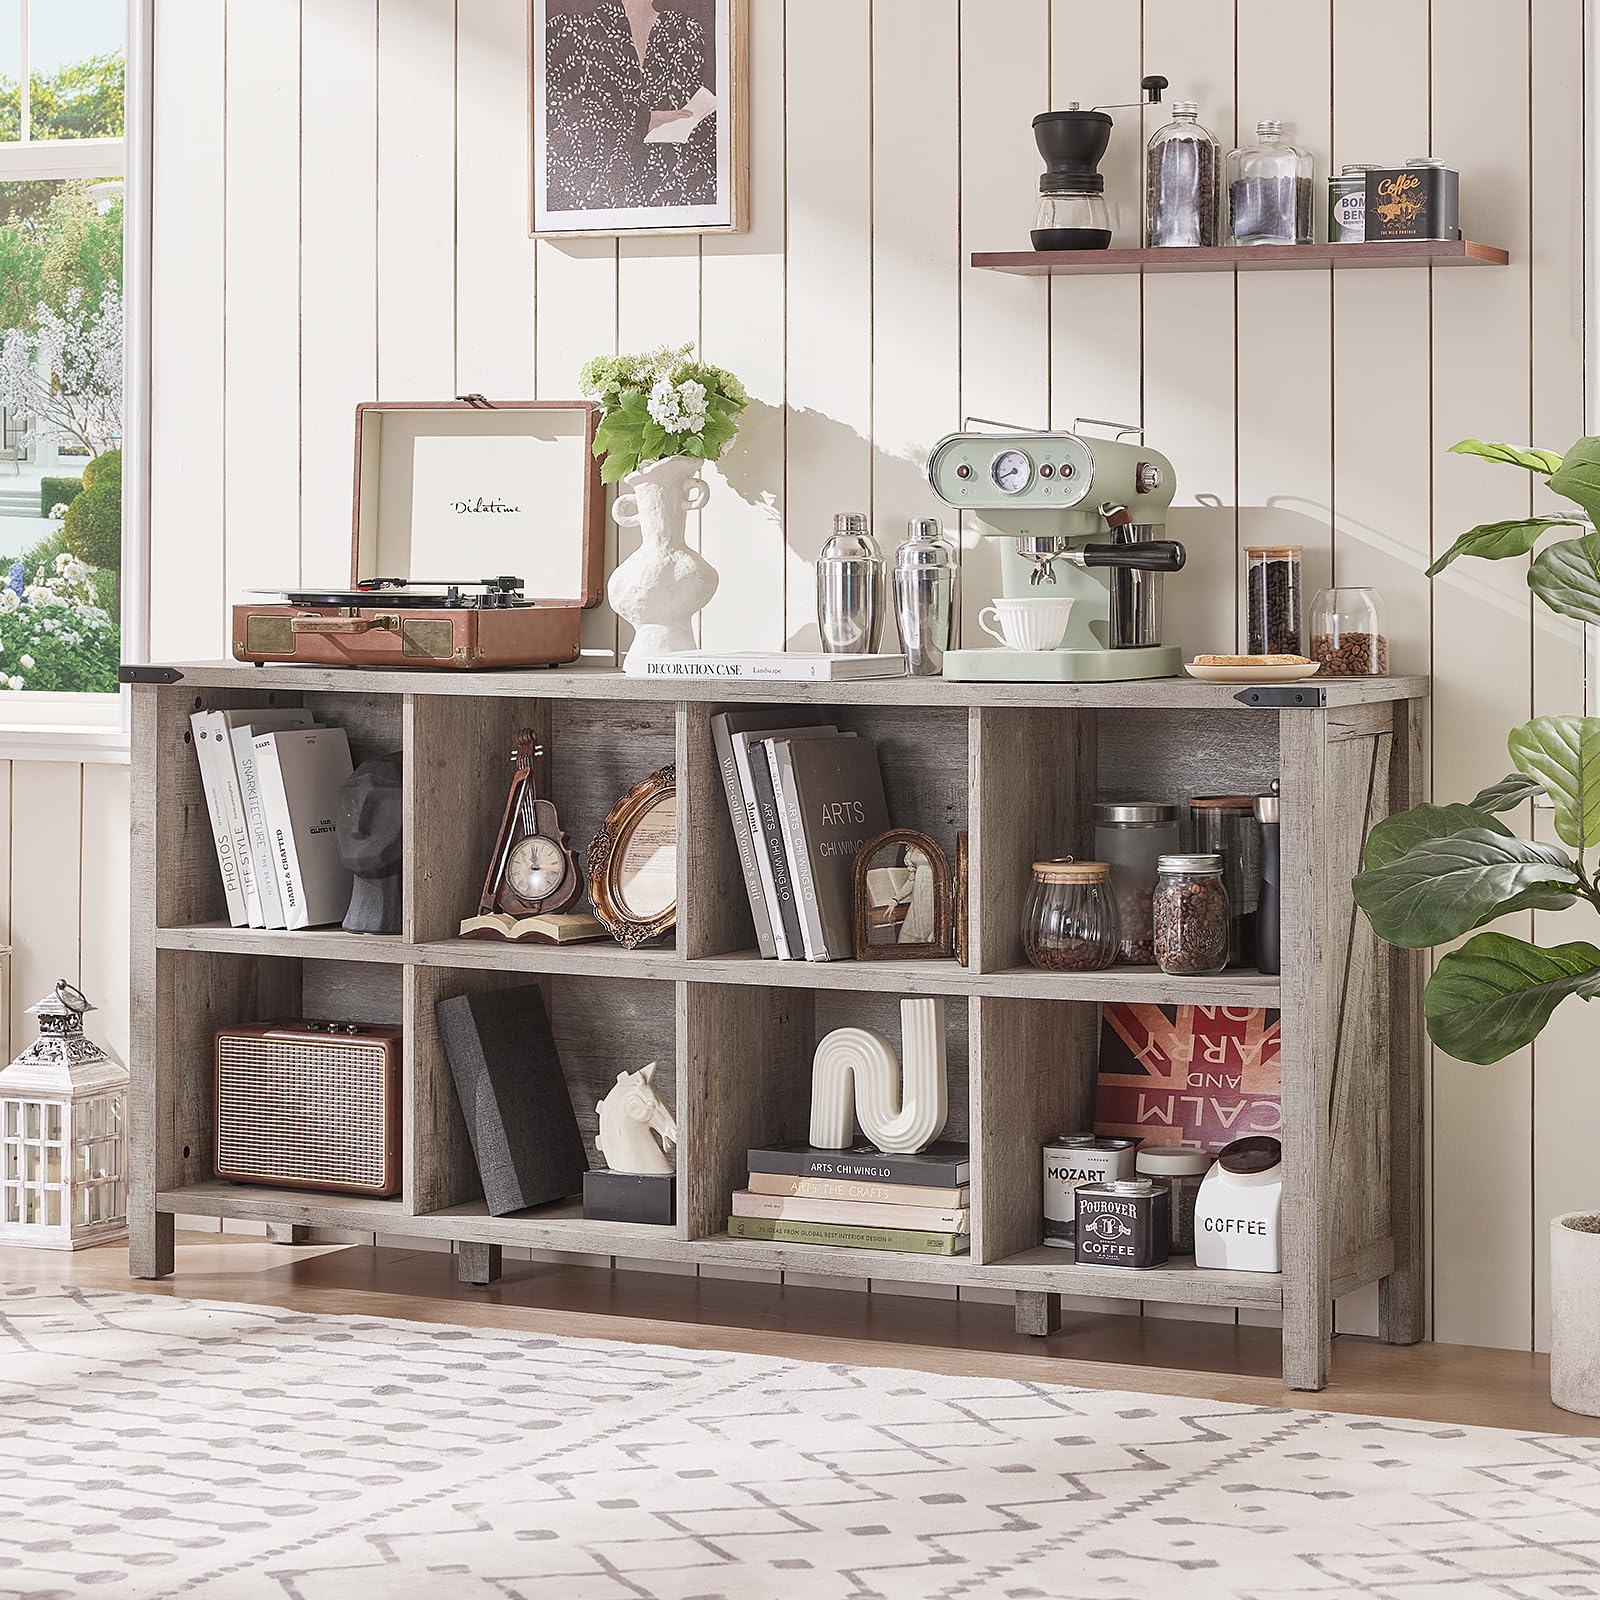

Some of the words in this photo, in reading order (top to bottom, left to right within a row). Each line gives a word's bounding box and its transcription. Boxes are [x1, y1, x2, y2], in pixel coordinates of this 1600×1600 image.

[1378, 173, 1420, 196] Coffee
[450, 497, 521, 514] Didatime
[647, 663, 714, 674] DECORATION
[716, 664, 742, 676] CASE
[752, 666, 782, 674] Landscape
[746, 801, 758, 834] Monet
[762, 802, 776, 830] ARTS
[787, 802, 800, 830] ARTS
[822, 800, 864, 826] ARTS
[242, 758, 266, 848] SNARKITECTURE
[264, 871, 272, 896] BEACH
[722, 758, 742, 825] White-collar
[740, 828, 756, 876] Women's
[750, 880, 760, 900] suit
[234, 827, 250, 866] STYLE
[276, 829, 289, 870] CRAFTED
[770, 838, 780, 856] CHI
[795, 838, 804, 856] CHI
[820, 842, 838, 856] CHI
[218, 834, 238, 892] PHOTOS
[774, 856, 786, 884] WING
[798, 856, 810, 884] WING
[242, 869, 254, 896] LIFE
[286, 880, 296, 908] MADE
[780, 886, 790, 900] LO
[804, 886, 812, 900] LO
[1187, 1072, 1241, 1089] AND
[1136, 1094, 1281, 1130] CALM
[810, 1162, 832, 1172] ARTS
[836, 1164, 852, 1174] CHI
[854, 1166, 876, 1176] WING
[879, 1168, 890, 1177] LO
[1048, 1167, 1106, 1182] MOZART
[790, 1182, 816, 1193] ARTS
[824, 1184, 844, 1195] THE
[848, 1186, 889, 1199] CRAFTS
[1204, 1217, 1266, 1236] COFFEE
[1082, 1240, 1135, 1256] COFFEE
